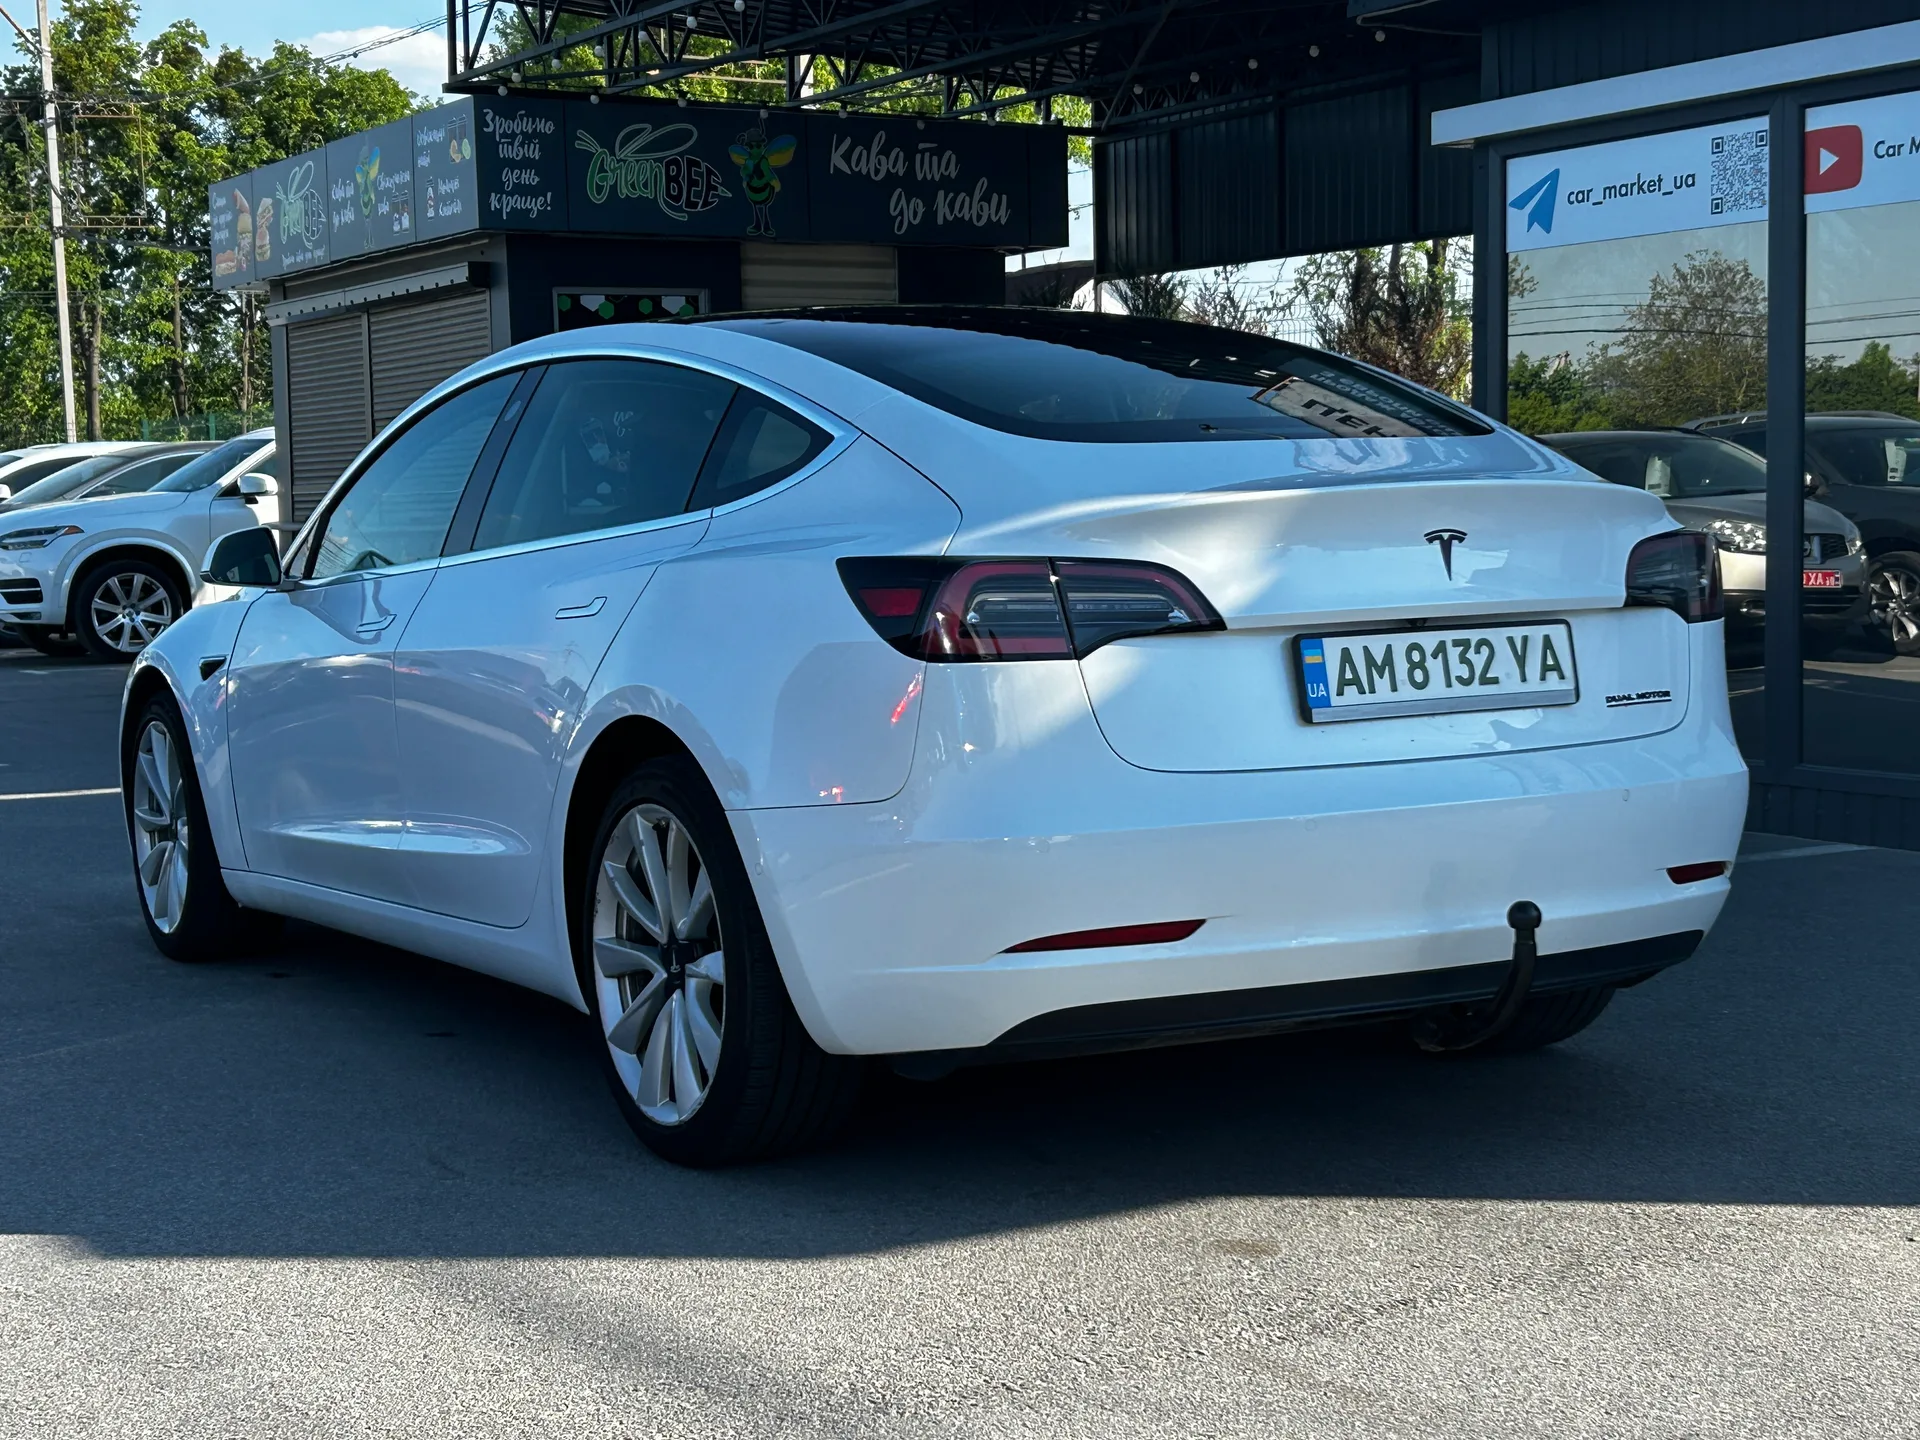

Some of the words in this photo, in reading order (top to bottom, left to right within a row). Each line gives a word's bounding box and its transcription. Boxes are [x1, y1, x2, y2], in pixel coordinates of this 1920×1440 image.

[483, 109, 555, 141] Зробимо
[499, 135, 541, 160] твій
[830, 130, 908, 181] Кава
[915, 143, 960, 181] та
[1873, 140, 1905, 159] Car
[502, 167, 540, 190] день
[1567, 172, 1696, 206] car_market_ua
[488, 192, 552, 219] краще!
[889, 188, 926, 234] до
[933, 177, 1011, 227] кави
[1335, 643, 1398, 697] AM
[1404, 637, 1500, 691] 8132
[1506, 634, 1566, 682] YA
[1307, 683, 1327, 699] UA
[1605, 693, 1635, 703] DUAL
[1635, 690, 1671, 700] MOTOR
